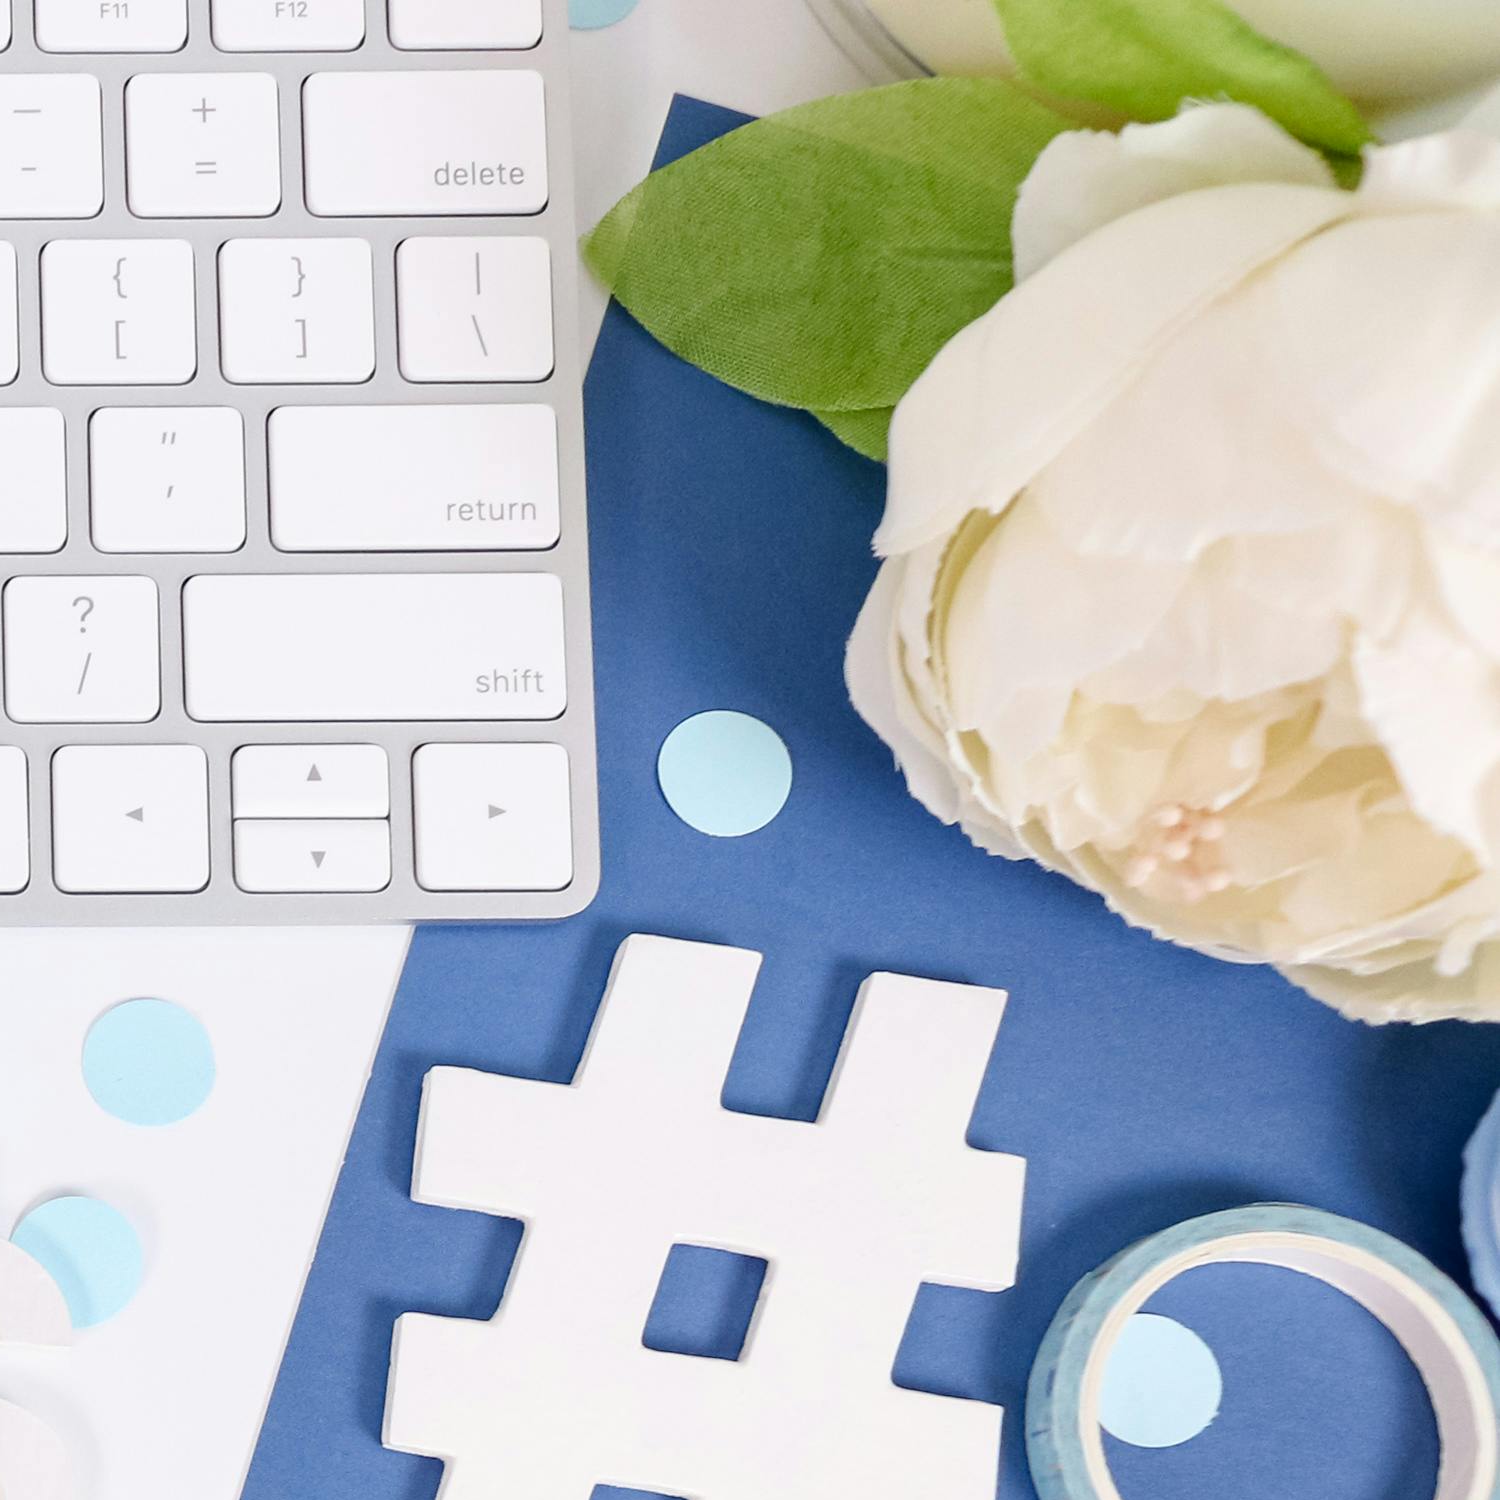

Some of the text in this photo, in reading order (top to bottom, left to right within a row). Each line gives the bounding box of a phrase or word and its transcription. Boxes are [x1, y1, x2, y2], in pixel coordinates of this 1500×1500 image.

[99, 2, 129, 19] F11
[274, 0, 308, 18] F12
[191, 97, 217, 124] +
[194, 161, 218, 175] =
[433, 161, 525, 187] delete
[112, 256, 128, 299] {
[290, 256, 306, 298] }
[114, 319, 127, 360] [
[294, 318, 308, 359] ]
[470, 314, 489, 357] \
[161, 431, 177, 445] "
[446, 499, 537, 522] return
[72, 595, 95, 634] ?
[76, 652, 92, 695] /
[475, 668, 544, 694] shift
